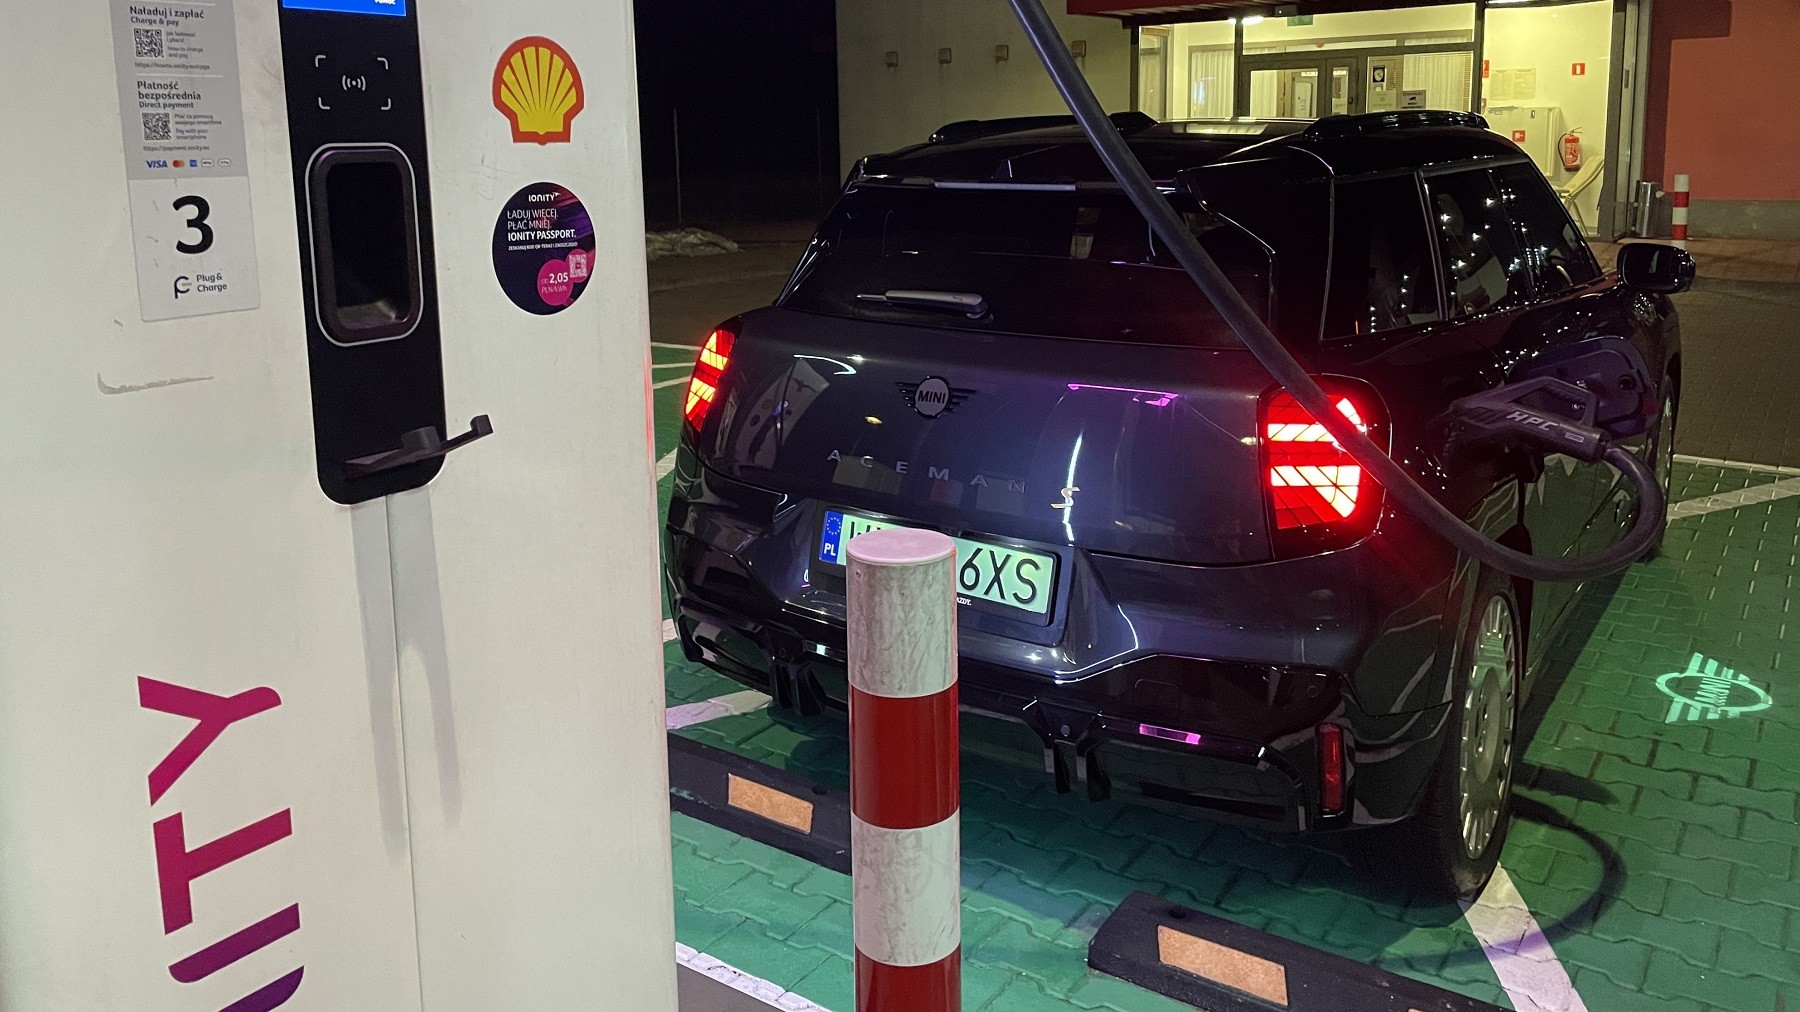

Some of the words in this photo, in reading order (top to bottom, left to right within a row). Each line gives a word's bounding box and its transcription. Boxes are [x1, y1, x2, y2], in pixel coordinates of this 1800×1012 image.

[129, 6, 168, 19] Naładuj
[169, 8, 173, 17] i
[174, 9, 205, 19] zapłać
[130, 16, 157, 26] Charge
[166, 19, 179, 27] pay
[137, 81, 179, 90] Płatność
[138, 90, 202, 100] bezpośrednia
[139, 101, 161, 109] Direct
[162, 101, 194, 110] payment
[146, 160, 168, 168] VISA
[528, 193, 556, 202] IONITY
[507, 210, 530, 220] ŁADUJ
[531, 209, 559, 220] WIĘCEJ.
[172, 195, 214, 254] 3
[507, 219, 527, 230] PŁAĆ
[529, 219, 552, 230] MNIEJ.
[508, 231, 535, 241] IONITY
[536, 229, 577, 240] PASSPORT.
[549, 272, 569, 285] 2,05
[197, 283, 227, 292] Charge
[918, 390, 946, 404] MINI
[1506, 411, 1559, 431] HPC
[826, 449, 1026, 494] ACEMAN
[823, 543, 837, 557] PL
[958, 547, 1042, 605] 6XS
